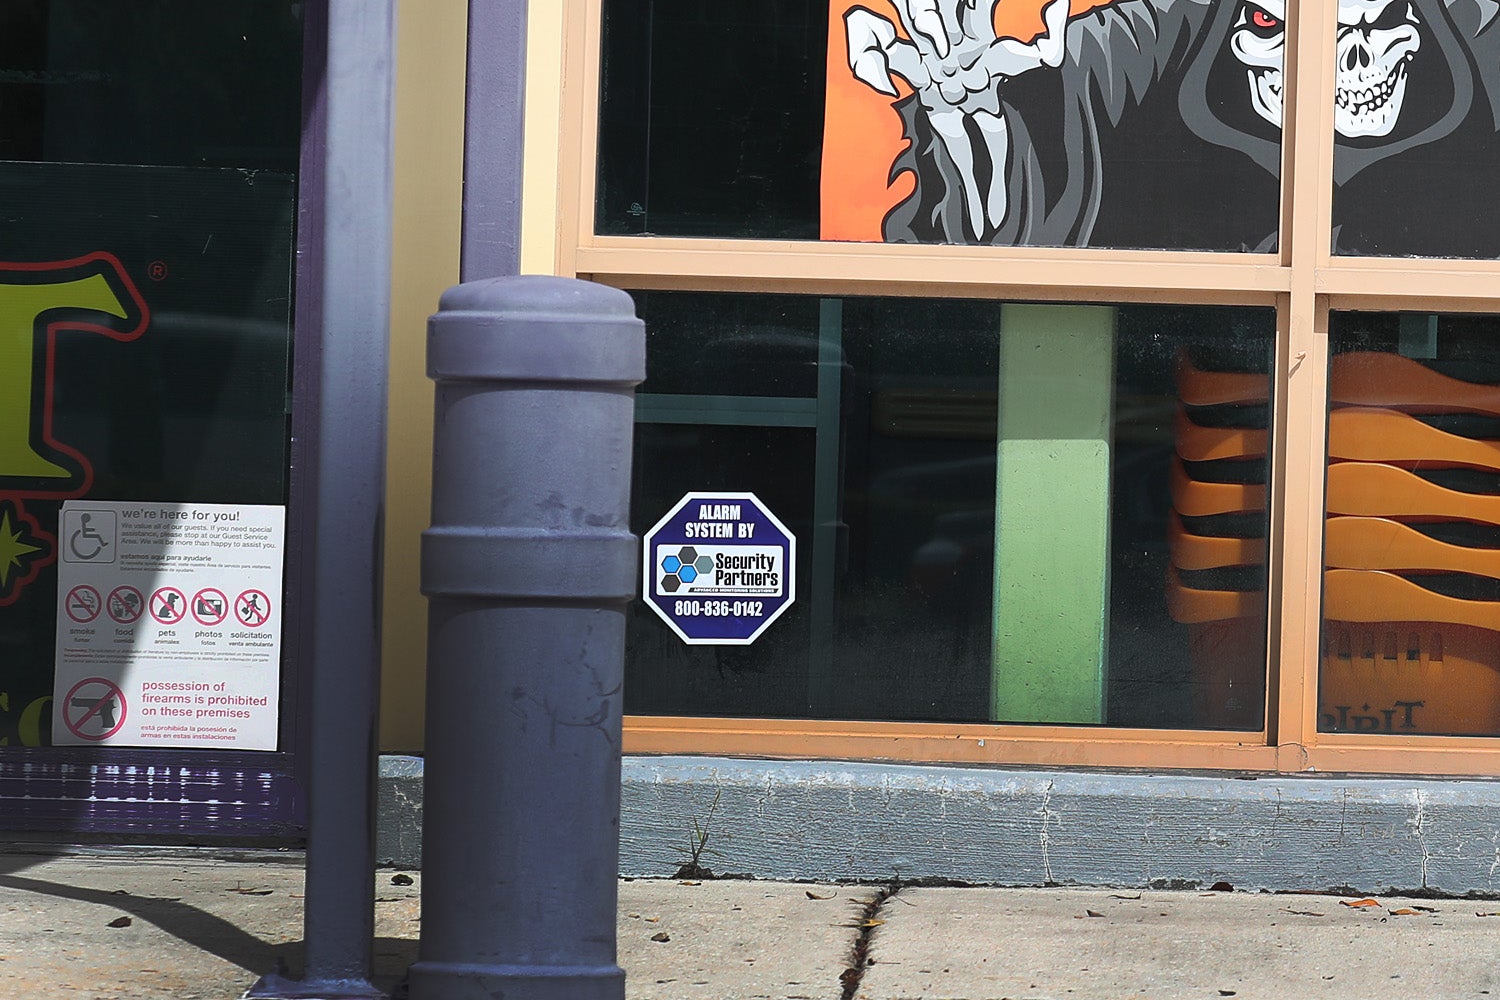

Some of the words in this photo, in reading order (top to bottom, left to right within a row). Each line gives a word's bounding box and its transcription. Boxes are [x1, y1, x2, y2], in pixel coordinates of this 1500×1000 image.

[122, 509, 156, 519] we're
[160, 509, 188, 520] here
[192, 510, 210, 520] for
[213, 511, 240, 522] you!
[698, 504, 741, 521] ALARM
[160, 531, 182, 539] please
[184, 532, 199, 540] stop
[685, 522, 733, 538] SYSTEM
[737, 522, 755, 539] BY
[211, 541, 232, 549] happy
[715, 553, 775, 572] Security
[715, 570, 779, 587] Partners
[674, 601, 763, 617] 800-836-0142
[69, 628, 96, 636] smoke
[115, 628, 134, 637] food
[158, 629, 176, 639] pets
[195, 630, 223, 640] photos
[230, 631, 273, 640] solicitation
[142, 681, 210, 693] possession
[213, 681, 226, 692] of
[142, 694, 191, 704] firearms
[194, 695, 204, 705] is
[207, 695, 268, 707] prohibited
[142, 708, 157, 716] on
[160, 707, 193, 717] these
[196, 708, 250, 719] premises
[196, 726, 228, 734] posesión
